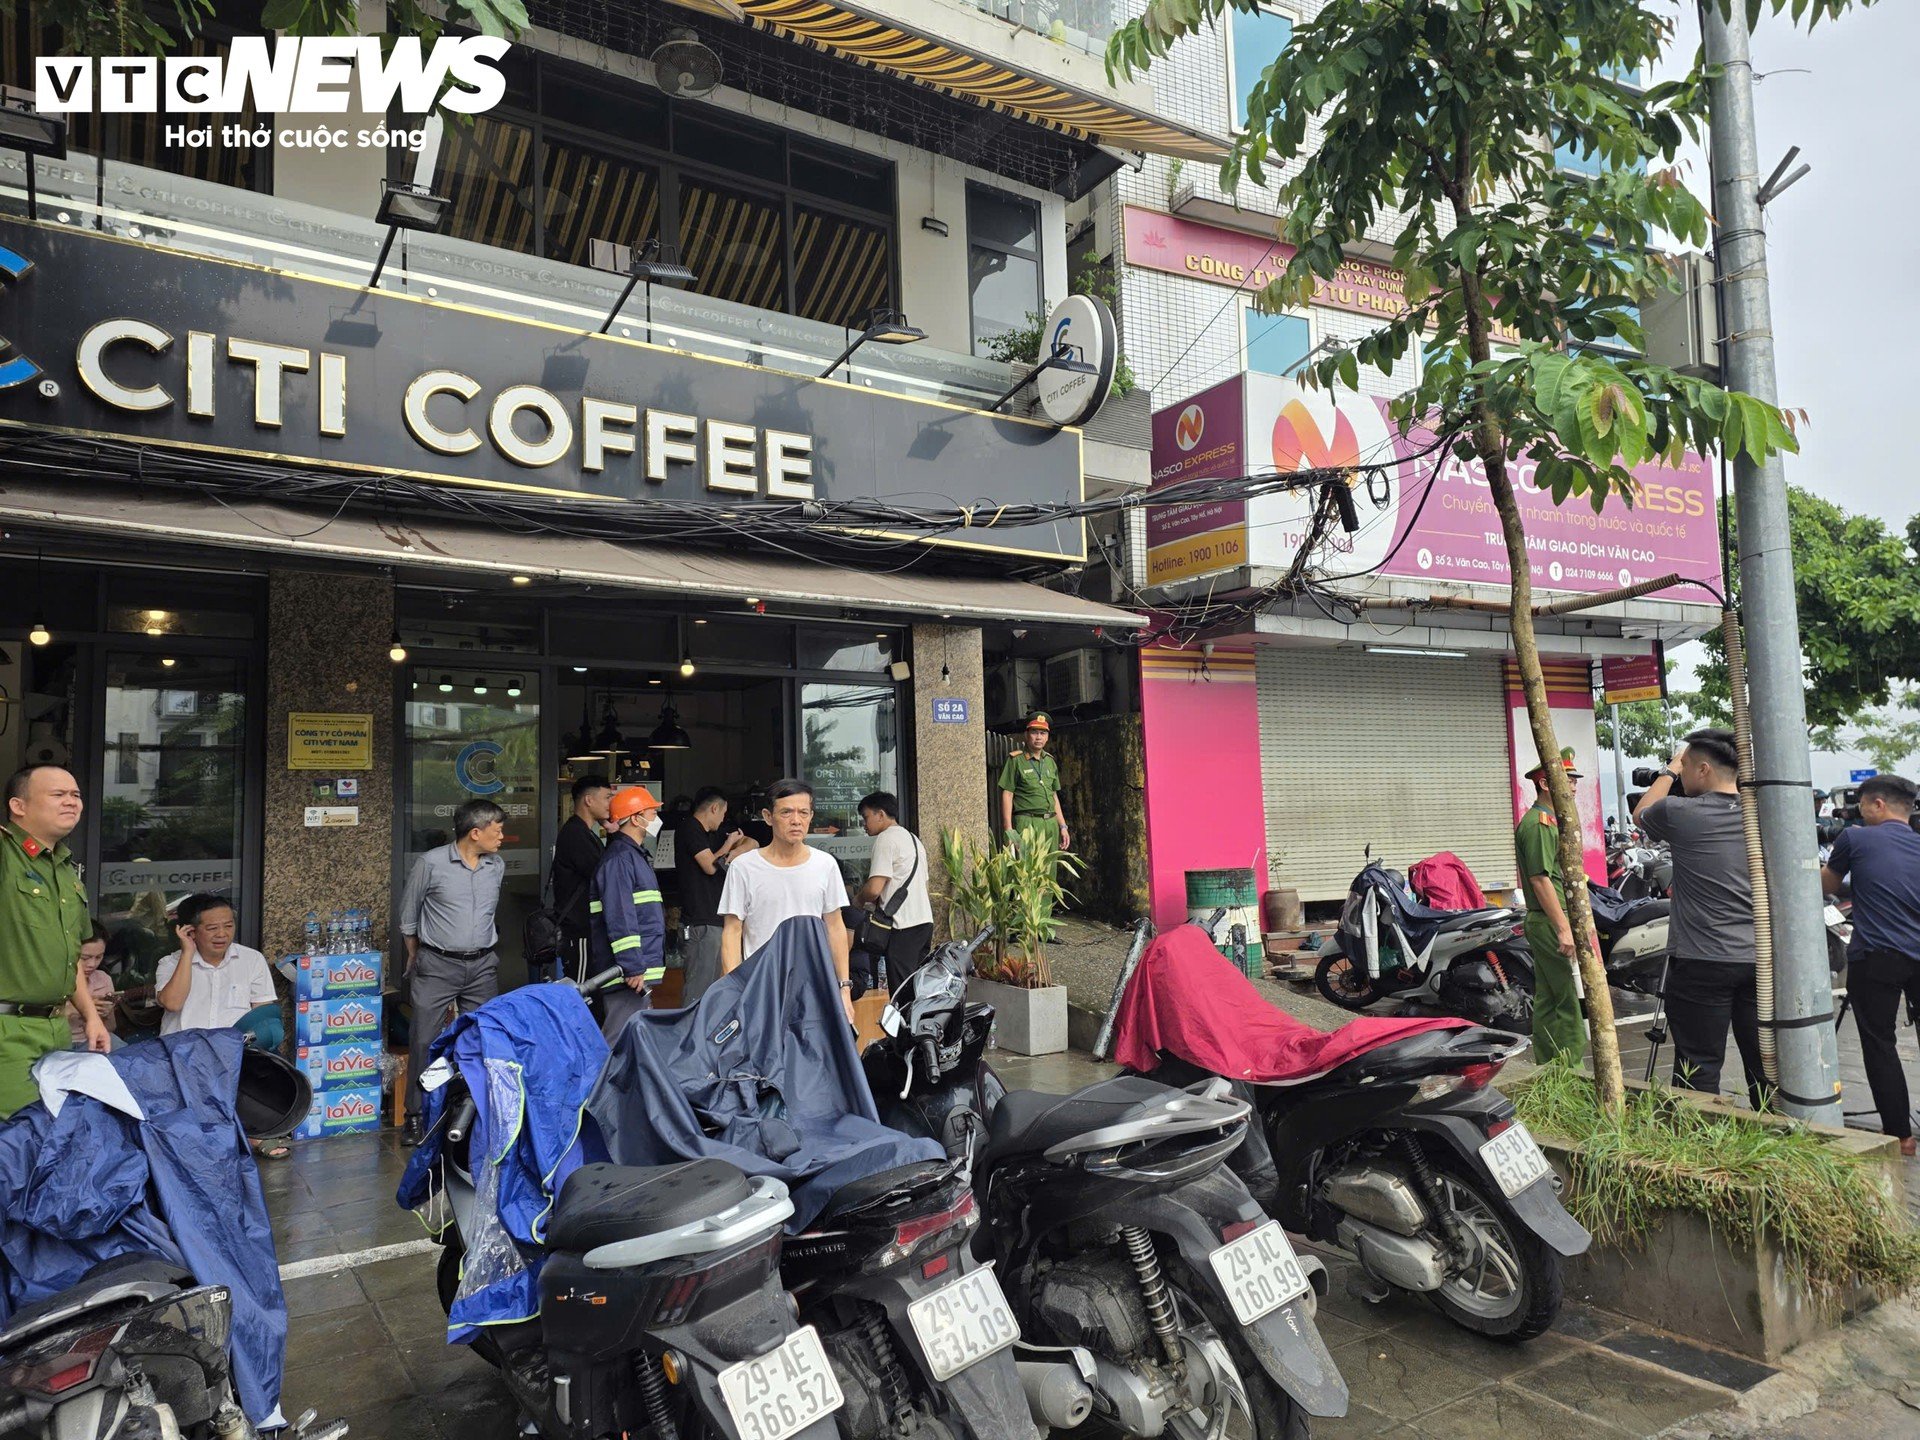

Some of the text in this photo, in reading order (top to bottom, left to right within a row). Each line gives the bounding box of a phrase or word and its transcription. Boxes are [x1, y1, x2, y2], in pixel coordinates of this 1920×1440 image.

[1185, 253, 1244, 283] CÔNG
[1253, 269, 1277, 286] TY
[1046, 373, 1087, 404] CITI COFFEE
[76, 316, 347, 438] CITI
[402, 369, 817, 500] COFFEE
[1151, 442, 1236, 481] NASCO EXPRESS
[1442, 493, 1492, 515] Chuyển
[1526, 505, 1564, 523] nhanh
[1566, 511, 1597, 531] trong
[1630, 518, 1643, 534] và
[1645, 521, 1673, 538] quốc
[1675, 523, 1687, 540] tế
[1152, 539, 1239, 574] Hotline: 1900 1106
[1435, 553, 1446, 566] Số
[1455, 557, 1471, 568] Văn
[1472, 558, 1491, 571] Cao,
[1548, 539, 1578, 555] GIAO
[1580, 540, 1605, 559] DỊCH
[1607, 544, 1630, 561] VĂN
[1631, 549, 1656, 563] CAO
[1565, 566, 1578, 578] 024
[1579, 567, 1597, 580] 7109
[937, 700, 964, 713] SỐ 2A
[937, 712, 965, 721] VĂN CAO
[338, 739, 359, 747] NAM
[815, 768, 842, 779] OPEN
[434, 804, 457, 817] CIT
[1488, 1129, 1529, 1167] 29-B1
[1499, 1148, 1544, 1192] 634.67
[1222, 1231, 1281, 1282] 29-AC
[209, 1290, 228, 1304] 150
[922, 1276, 991, 1334] 29-C1
[1235, 1259, 1302, 1316] 160.99
[928, 1306, 1012, 1372] 534.09
[736, 1338, 812, 1406] 29-AE
[743, 1372, 835, 1440] 366.52
